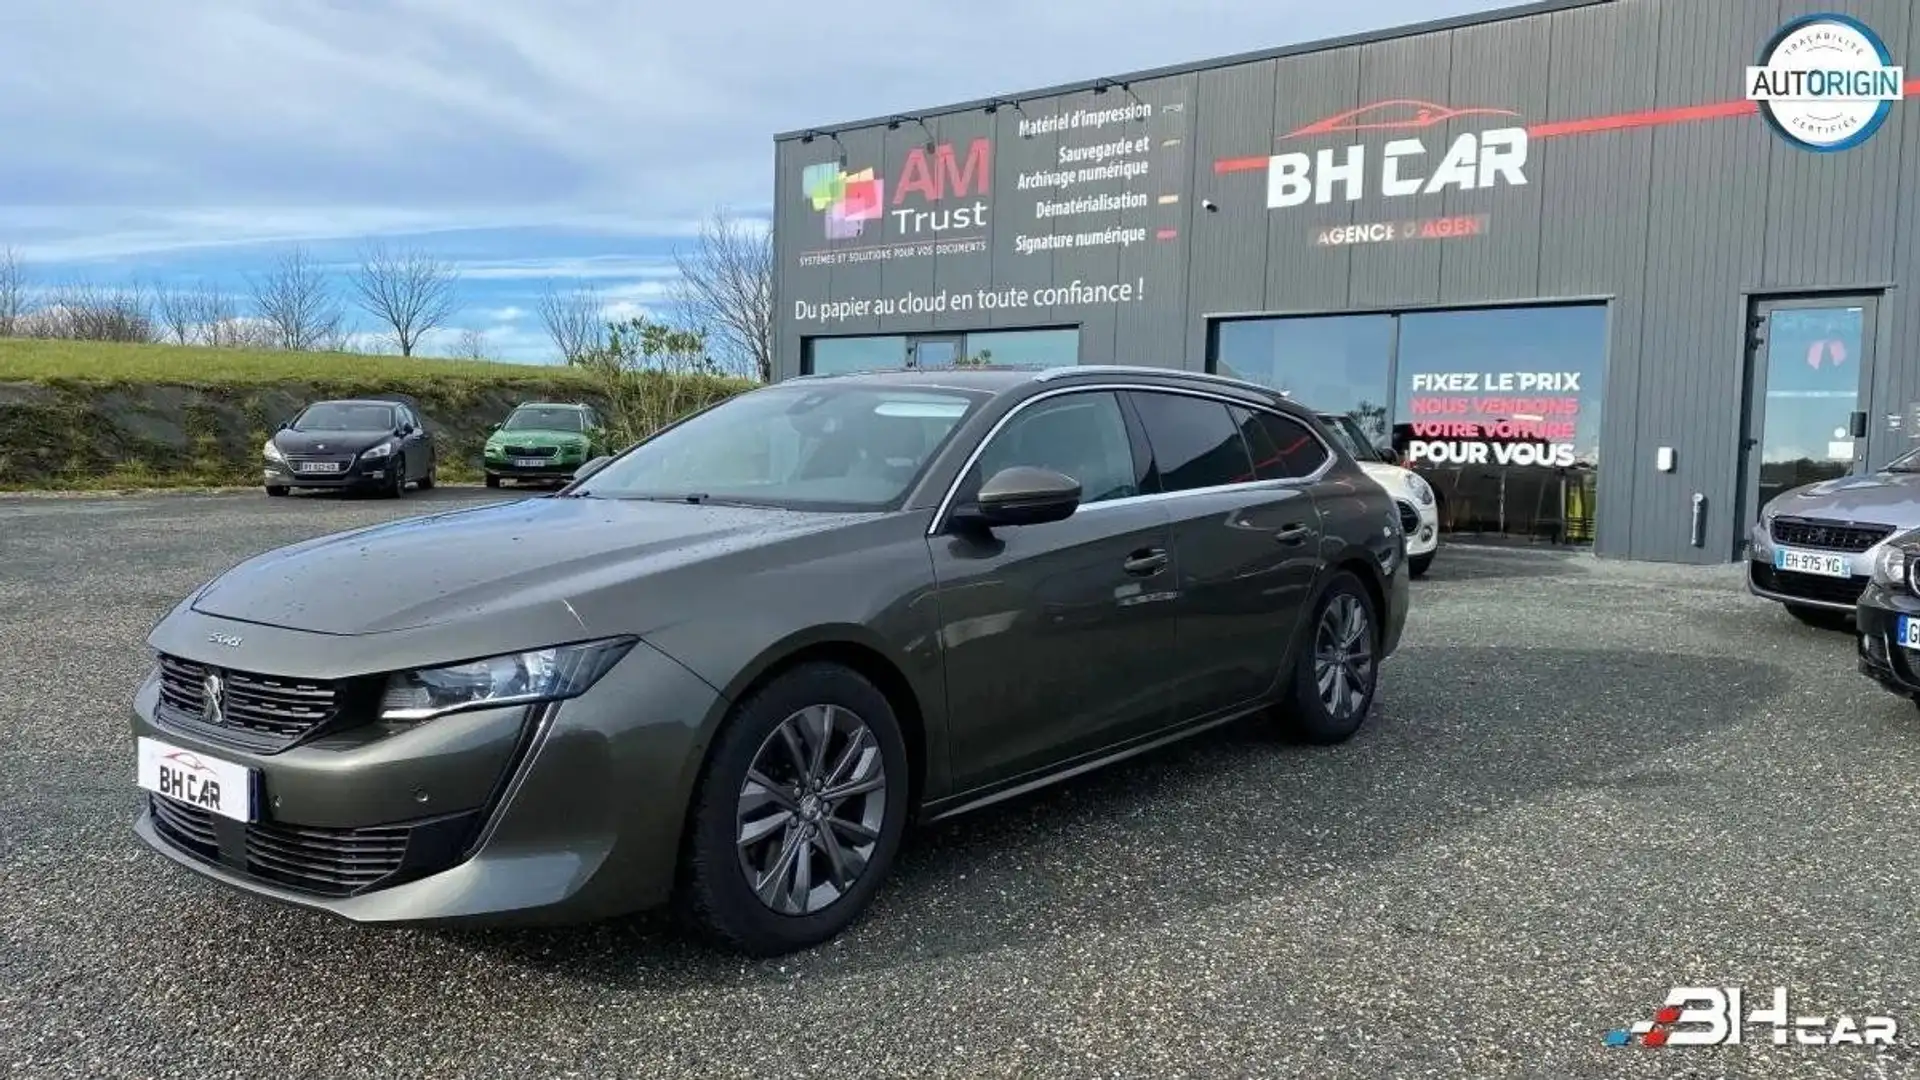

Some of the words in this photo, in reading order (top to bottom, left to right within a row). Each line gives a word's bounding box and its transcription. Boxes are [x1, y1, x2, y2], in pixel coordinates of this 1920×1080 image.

[1019, 112, 1069, 137] Matériel
[1071, 102, 1152, 129] d'impression
[1059, 138, 1132, 164] Sauvegarde
[1135, 136, 1150, 152] et
[893, 136, 990, 205] AM
[1017, 169, 1076, 190] Archivage
[1078, 159, 1149, 182] numérique
[1267, 145, 1365, 209] BH
[1382, 127, 1528, 197] CAR
[891, 201, 988, 235] Trust
[1036, 191, 1148, 219] Dématérialisation
[837, 252, 847, 264] ET
[849, 249, 892, 263] SOLUTIONS
[894, 248, 914, 259] POUR
[917, 245, 934, 257] VOS
[936, 240, 986, 255] DOCUMENTS
[1015, 233, 1074, 255] Signature
[1075, 227, 1146, 247] numérique
[795, 300, 816, 320] Du
[821, 297, 870, 323] papier
[874, 298, 895, 316] au
[899, 290, 946, 314] cloud
[950, 294, 973, 311] en
[978, 287, 1028, 309] toute
[1033, 280, 1133, 307] confiance
[1138, 277, 1144, 300] !
[1412, 373, 1479, 391] FIXEZ
[1485, 373, 1514, 391] LE
[1518, 372, 1581, 391] PRIX
[1412, 398, 1469, 414] NOUS
[1474, 397, 1579, 415] VENDONS
[1412, 421, 1479, 437] VOTRE
[1482, 421, 1575, 439] VOITURE
[1409, 440, 1488, 465] POUR
[1492, 442, 1576, 467] VOUS
[1911, 623, 1920, 645] G
[159, 765, 184, 800] BH
[187, 774, 222, 811] CAR
